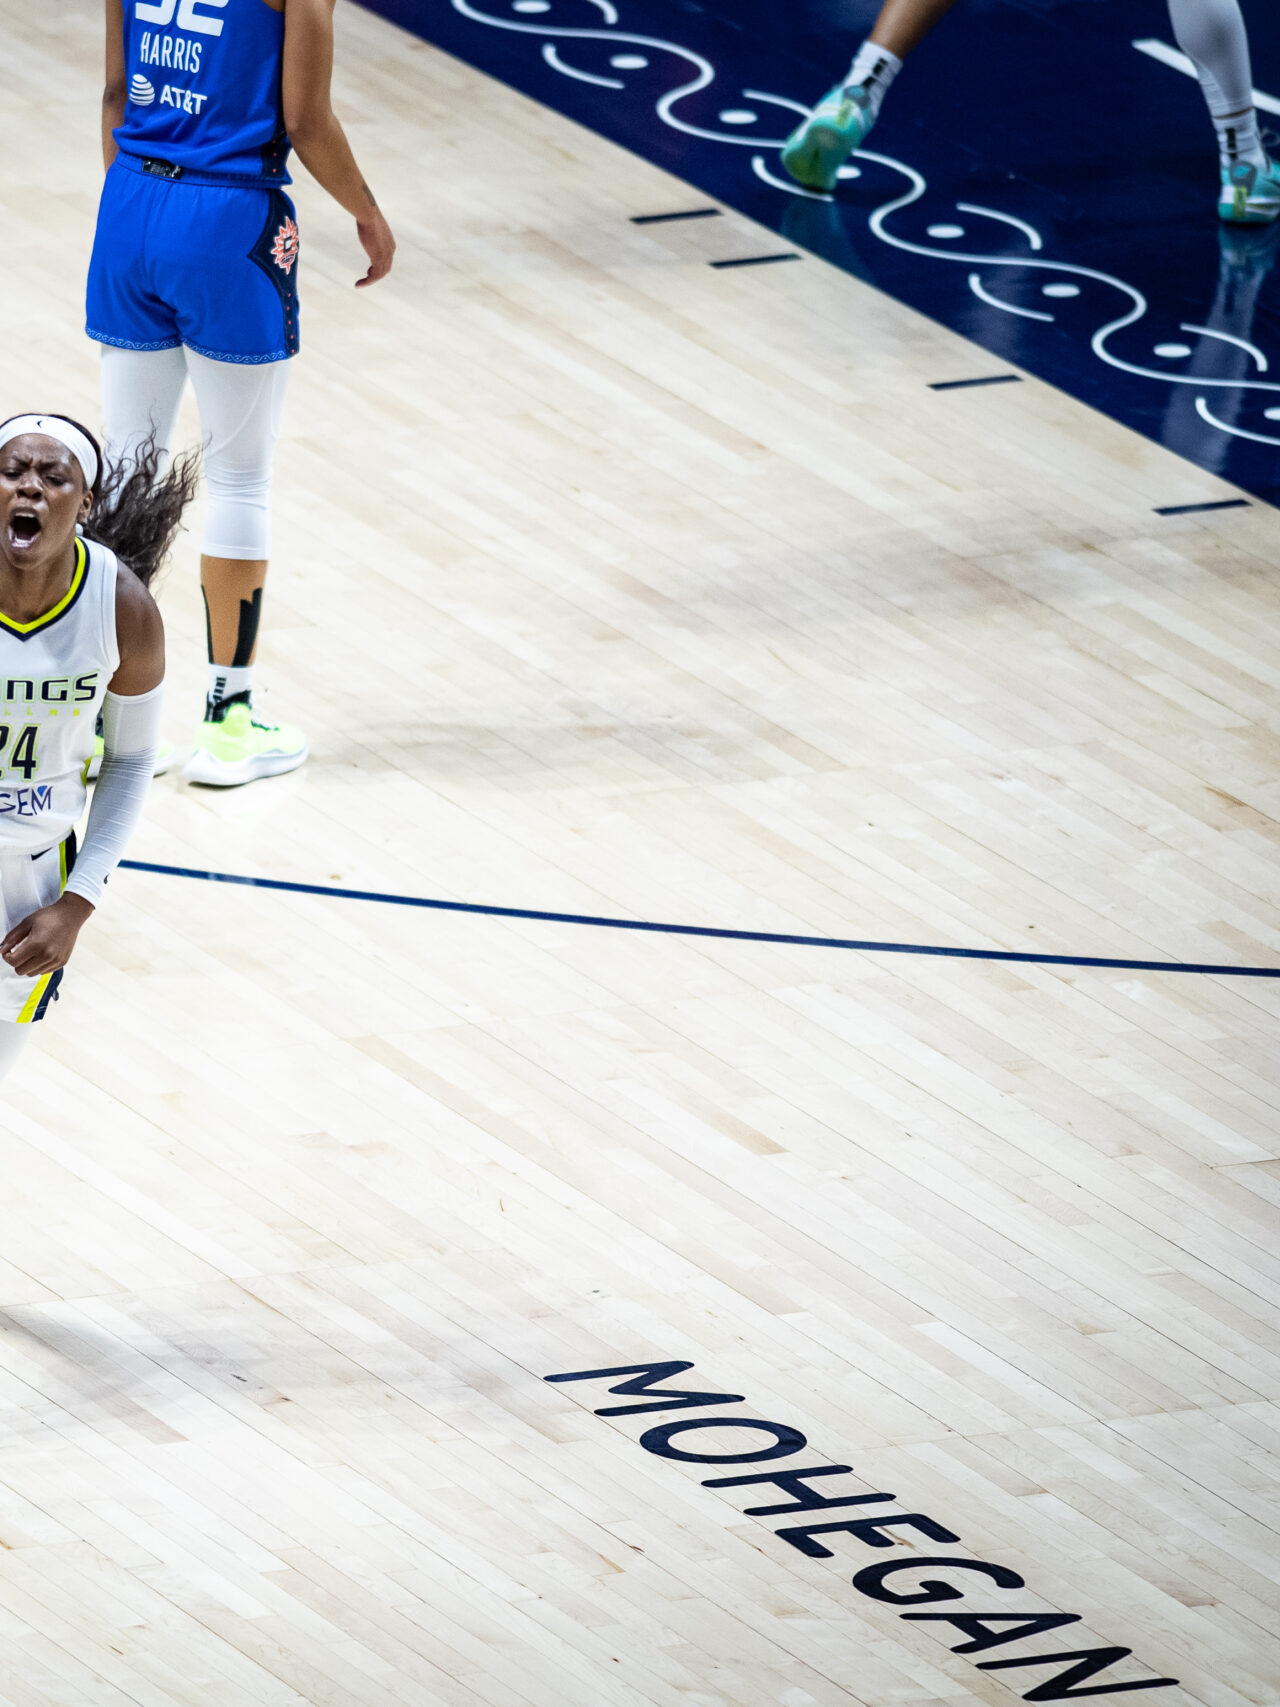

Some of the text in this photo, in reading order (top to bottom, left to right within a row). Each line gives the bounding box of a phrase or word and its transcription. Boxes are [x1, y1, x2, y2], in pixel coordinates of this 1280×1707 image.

[140, 31, 202, 73] HARRIS
[160, 84, 208, 114] AT&T
[543, 1360, 1181, 1701] MOHEGAN
